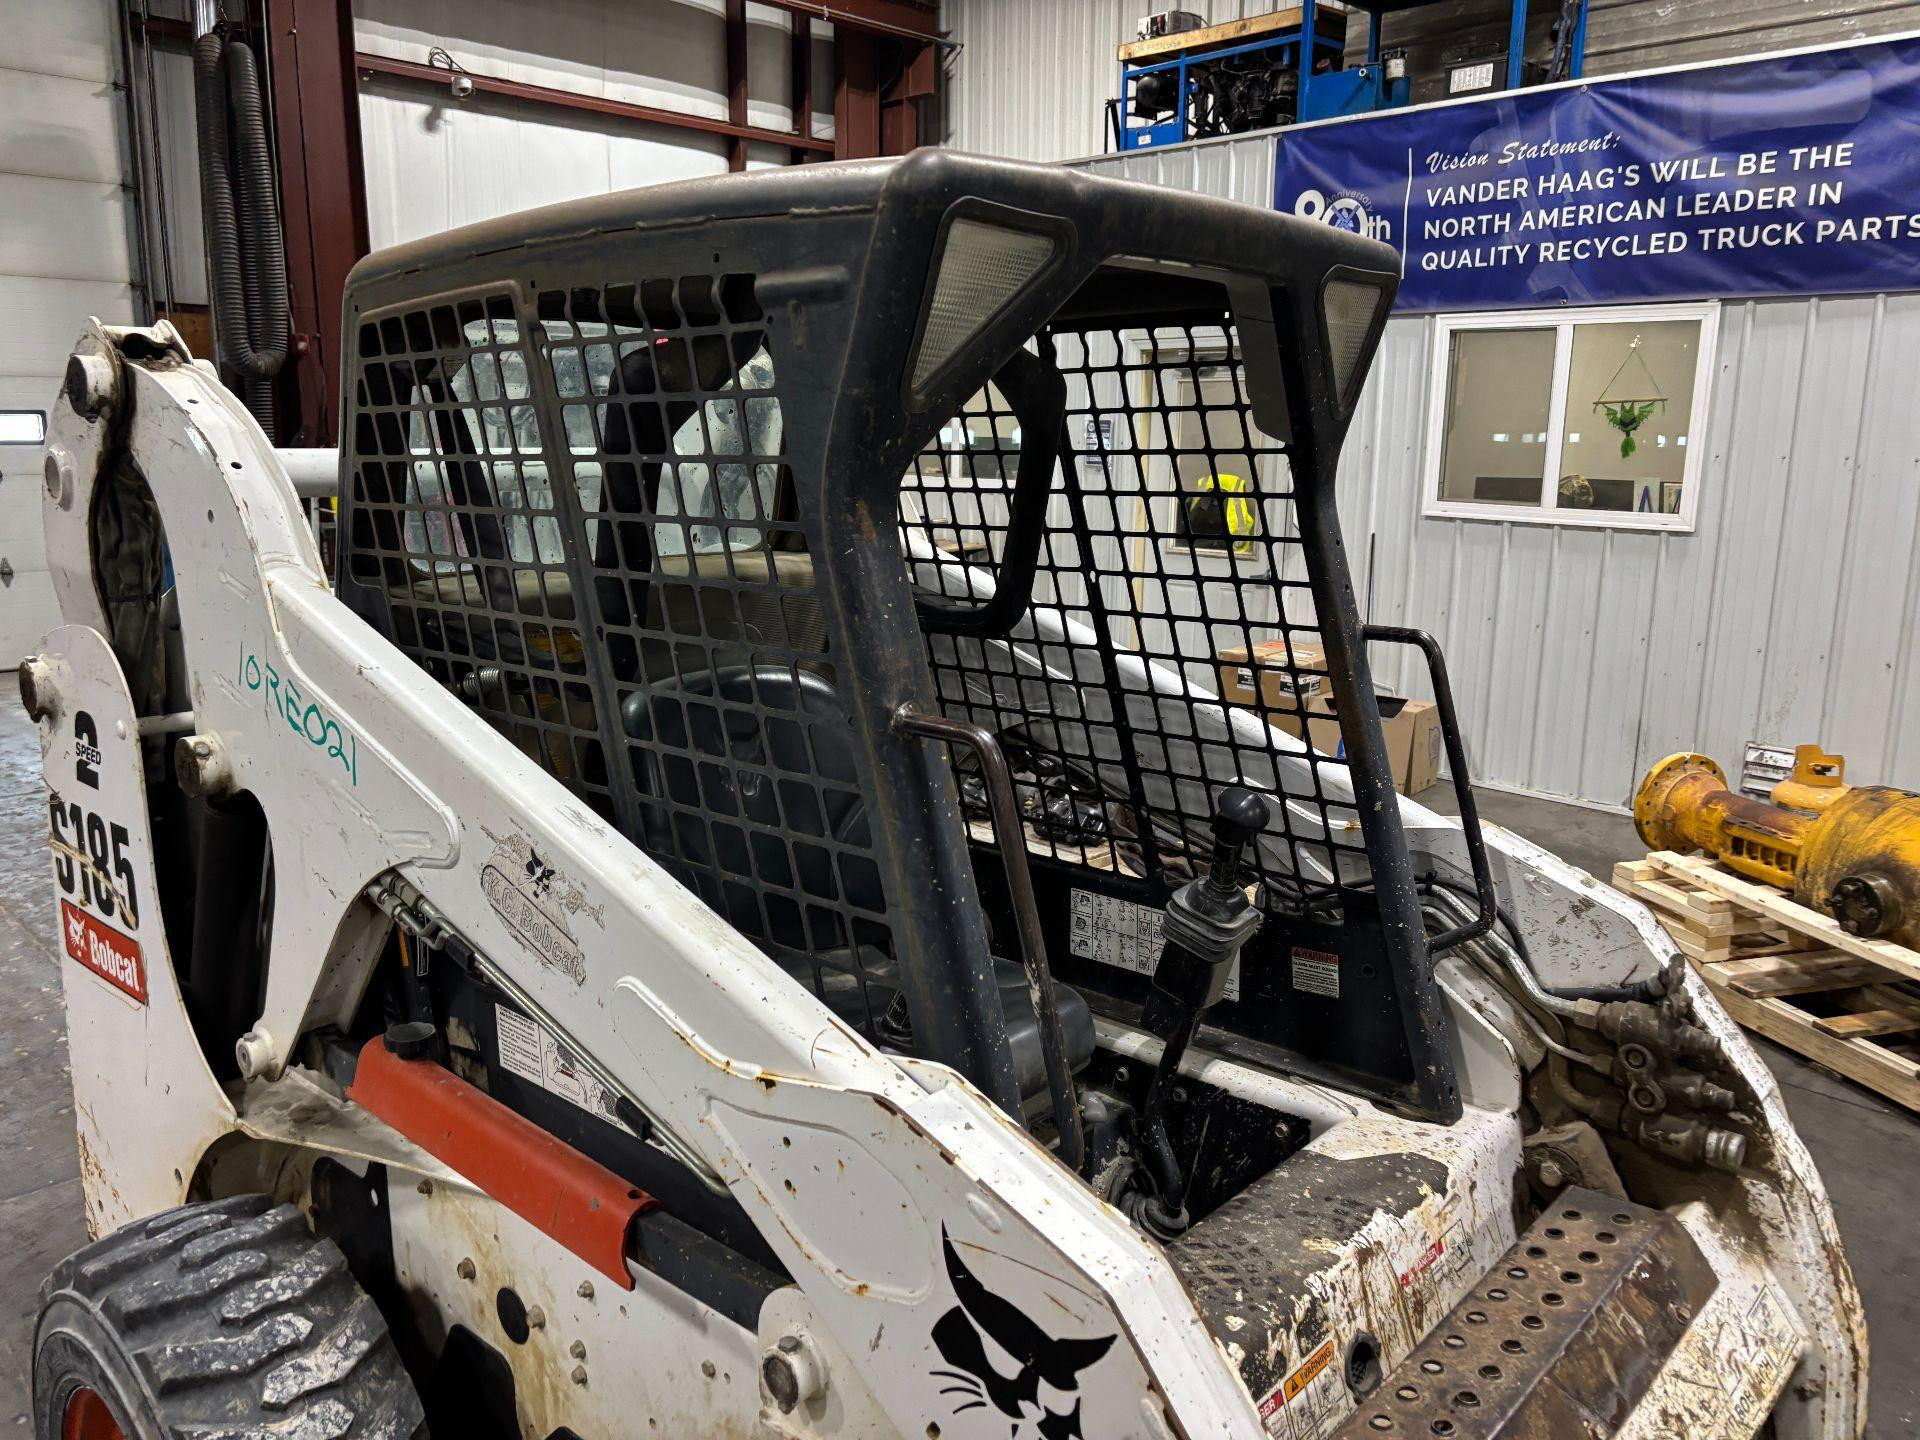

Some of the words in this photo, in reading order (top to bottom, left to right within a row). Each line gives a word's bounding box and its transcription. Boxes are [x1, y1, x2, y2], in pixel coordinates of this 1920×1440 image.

[1425, 151, 1489, 174] Vision
[1498, 131, 1621, 165] Statement:
[1427, 178, 1528, 208] VANDER
[1538, 164, 1640, 196] HAAG'S
[1651, 157, 1726, 184] WILL
[1737, 151, 1778, 176] BE
[1789, 143, 1854, 171] THE
[1424, 212, 1512, 240] NORTH
[1519, 197, 1666, 232] AMERICAN
[1676, 186, 1796, 217] LEADER
[1808, 181, 1843, 206] IN
[1421, 243, 1531, 271] QUALITY
[1539, 231, 1688, 263] RECYCLED
[1697, 221, 1806, 251] TRUCK
[1816, 214, 1920, 243] PARTS
[75, 710, 99, 790] 2
[75, 741, 102, 765] SPEED
[50, 793, 139, 931] S185
[88, 929, 140, 992] Bobcat
[1301, 1347, 1332, 1379] WARNING
